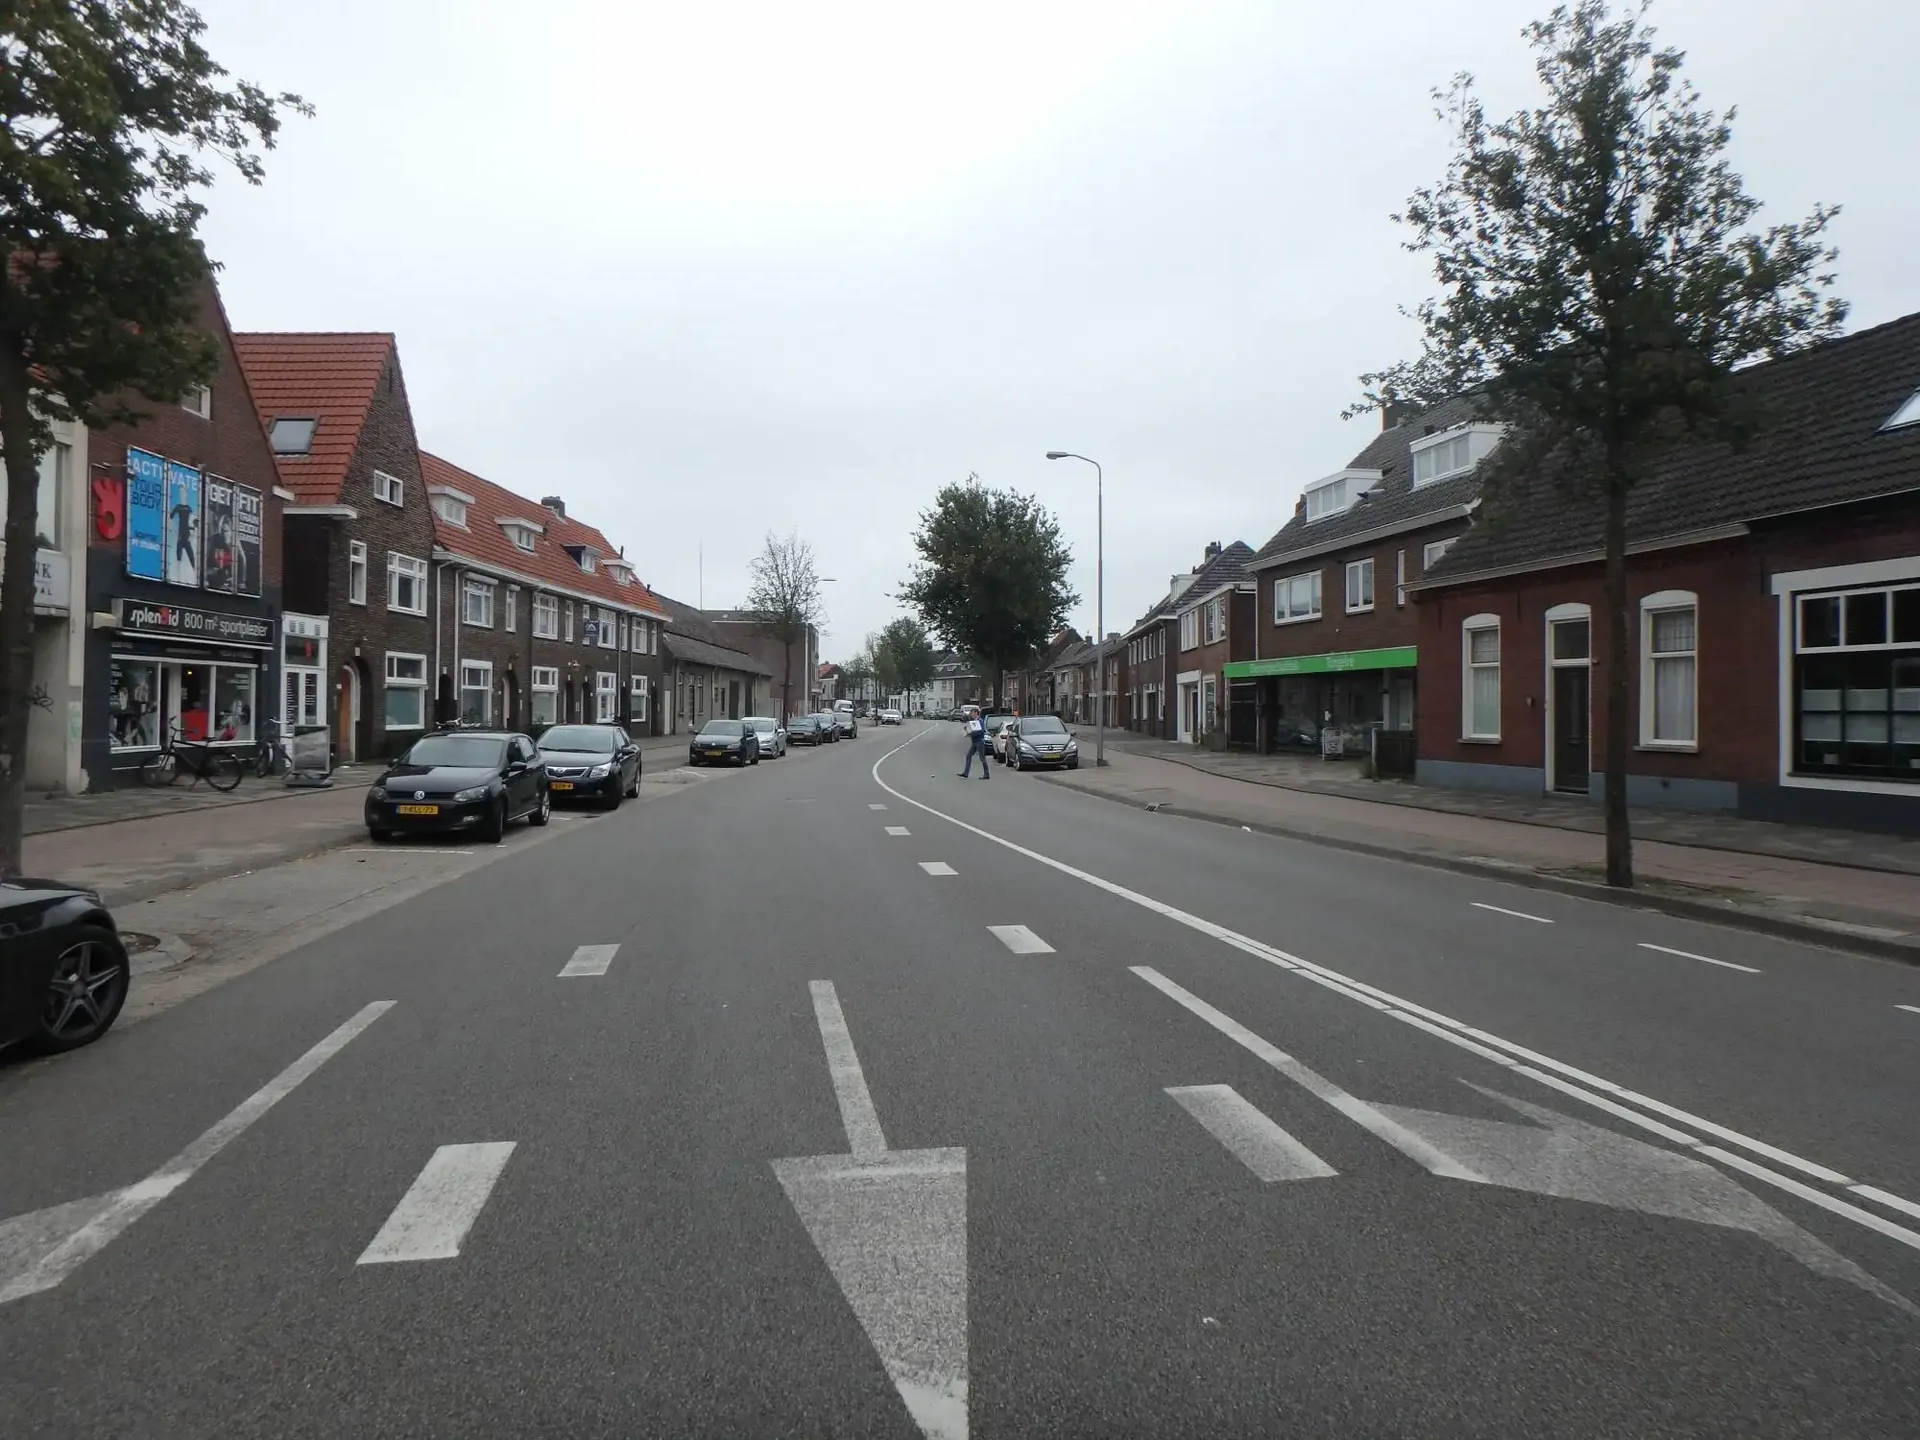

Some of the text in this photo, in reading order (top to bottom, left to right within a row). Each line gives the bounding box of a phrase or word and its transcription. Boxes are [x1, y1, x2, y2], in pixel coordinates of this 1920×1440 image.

[131, 490, 161, 509] BODY
[209, 483, 260, 514] GET FIT
[184, 612, 203, 629] 800
